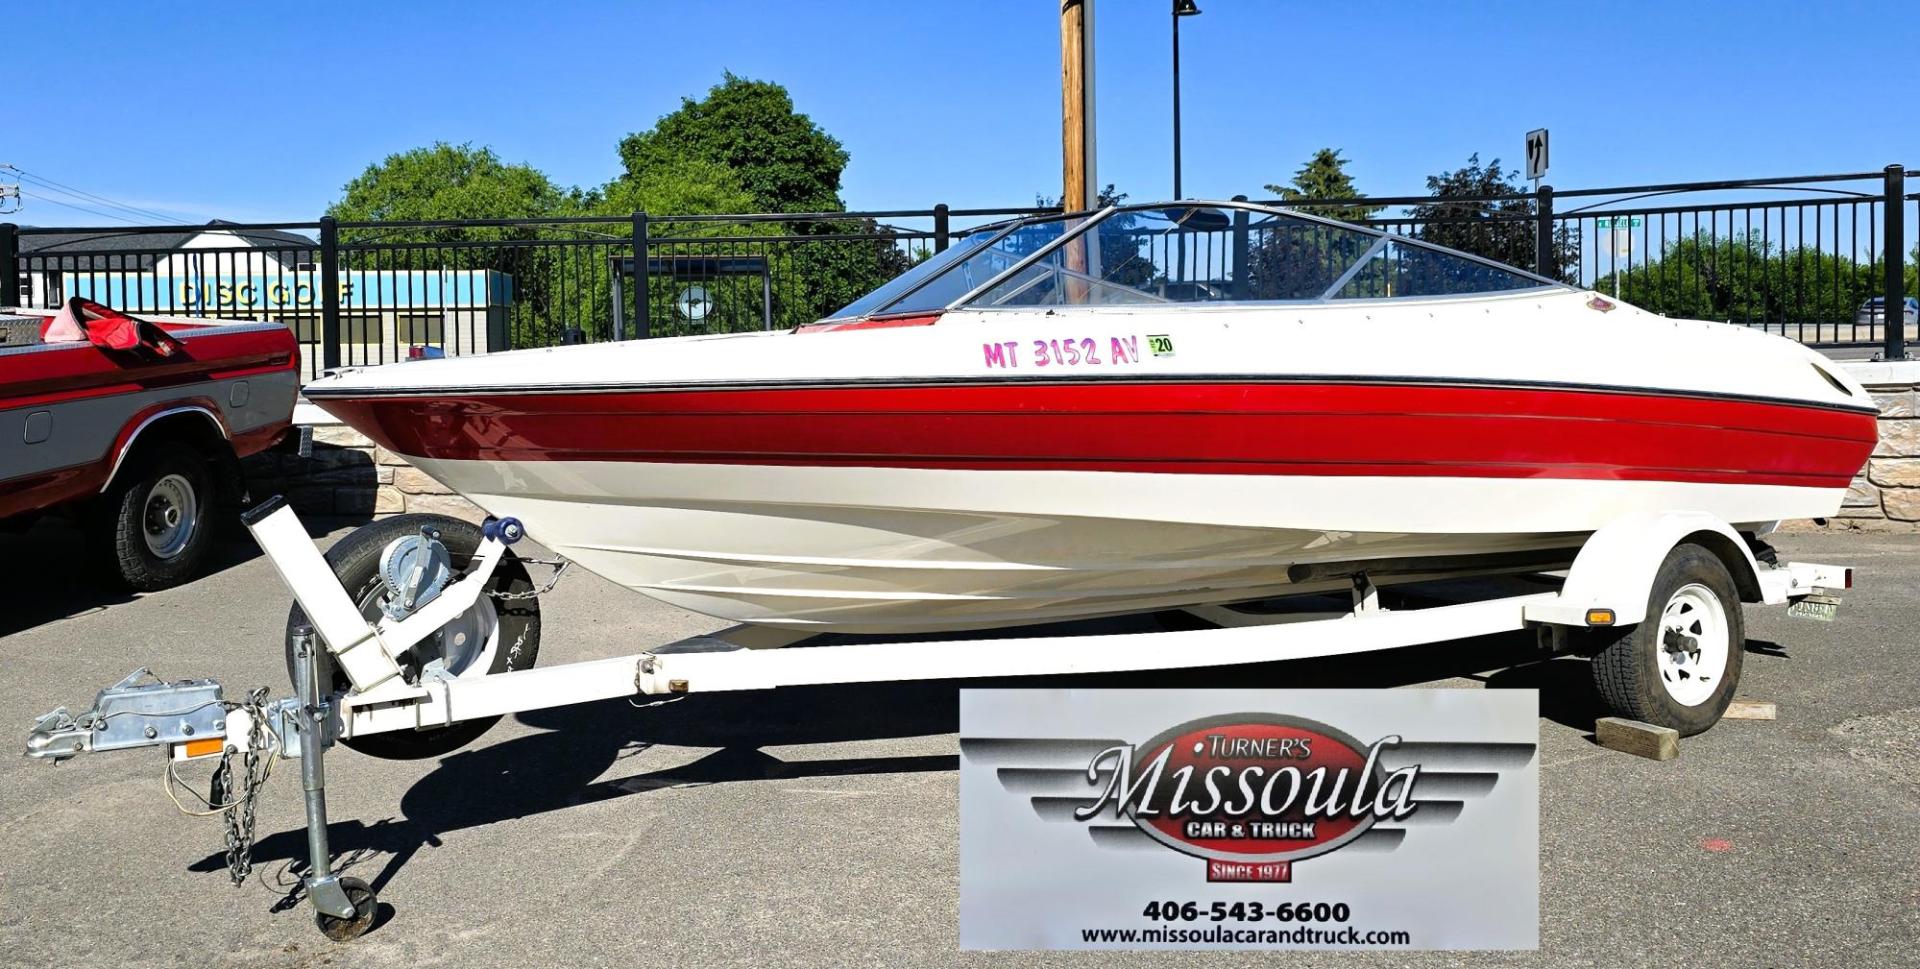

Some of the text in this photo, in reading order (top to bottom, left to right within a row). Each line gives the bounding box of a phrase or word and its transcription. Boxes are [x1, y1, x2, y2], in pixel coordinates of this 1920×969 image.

[179, 281, 354, 306] DISC GOF
[983, 335, 1139, 368] MT 3152 AV
[1155, 337, 1173, 352] 20
